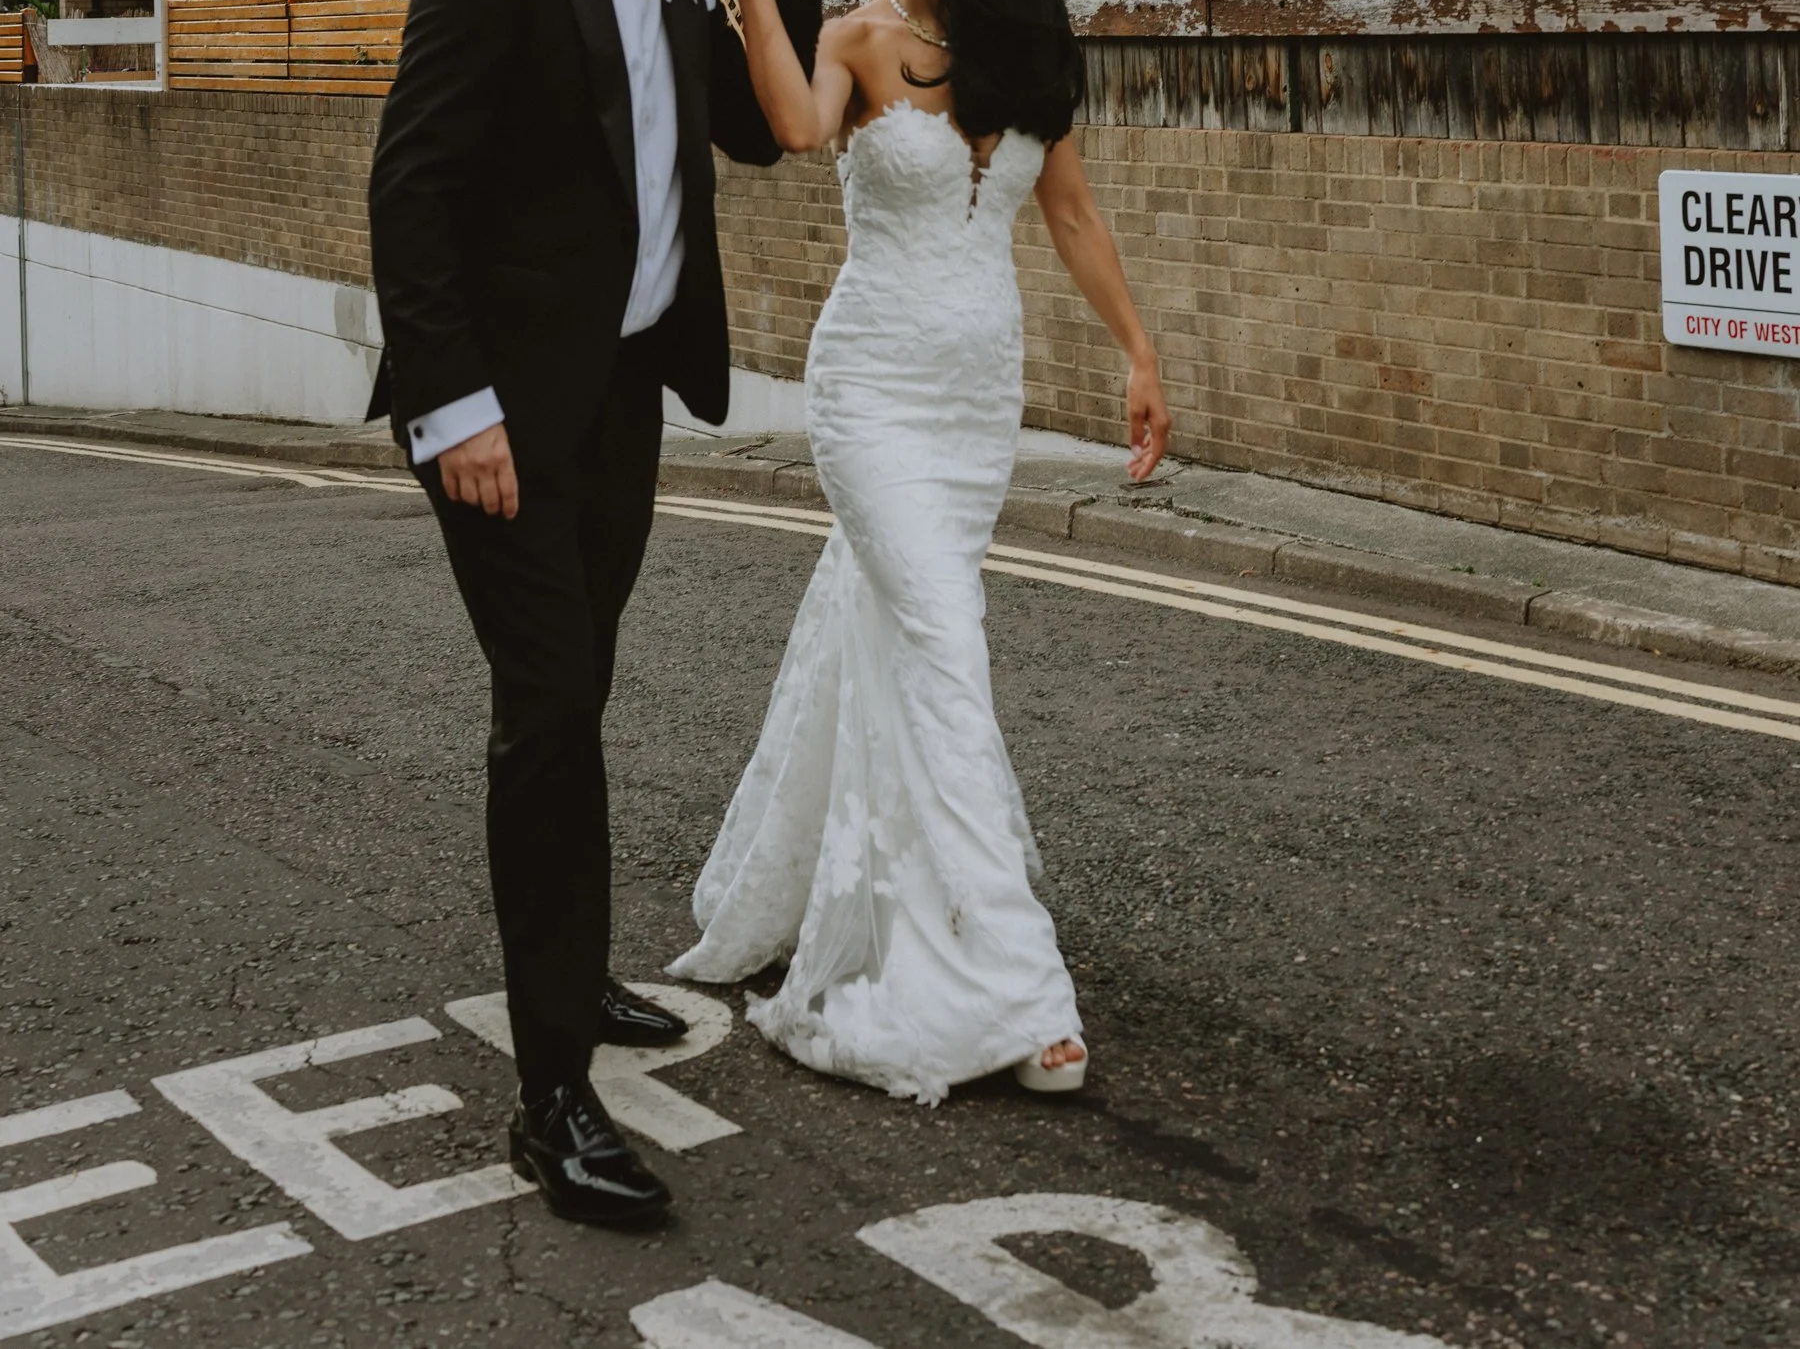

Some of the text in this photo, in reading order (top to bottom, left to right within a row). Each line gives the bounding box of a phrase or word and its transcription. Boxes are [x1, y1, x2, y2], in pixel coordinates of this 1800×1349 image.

[1682, 190, 1800, 238] CLEAR
[1684, 245, 1793, 294] DRIVE
[1686, 315, 1721, 337] CITY
[1727, 319, 1748, 340] OF
